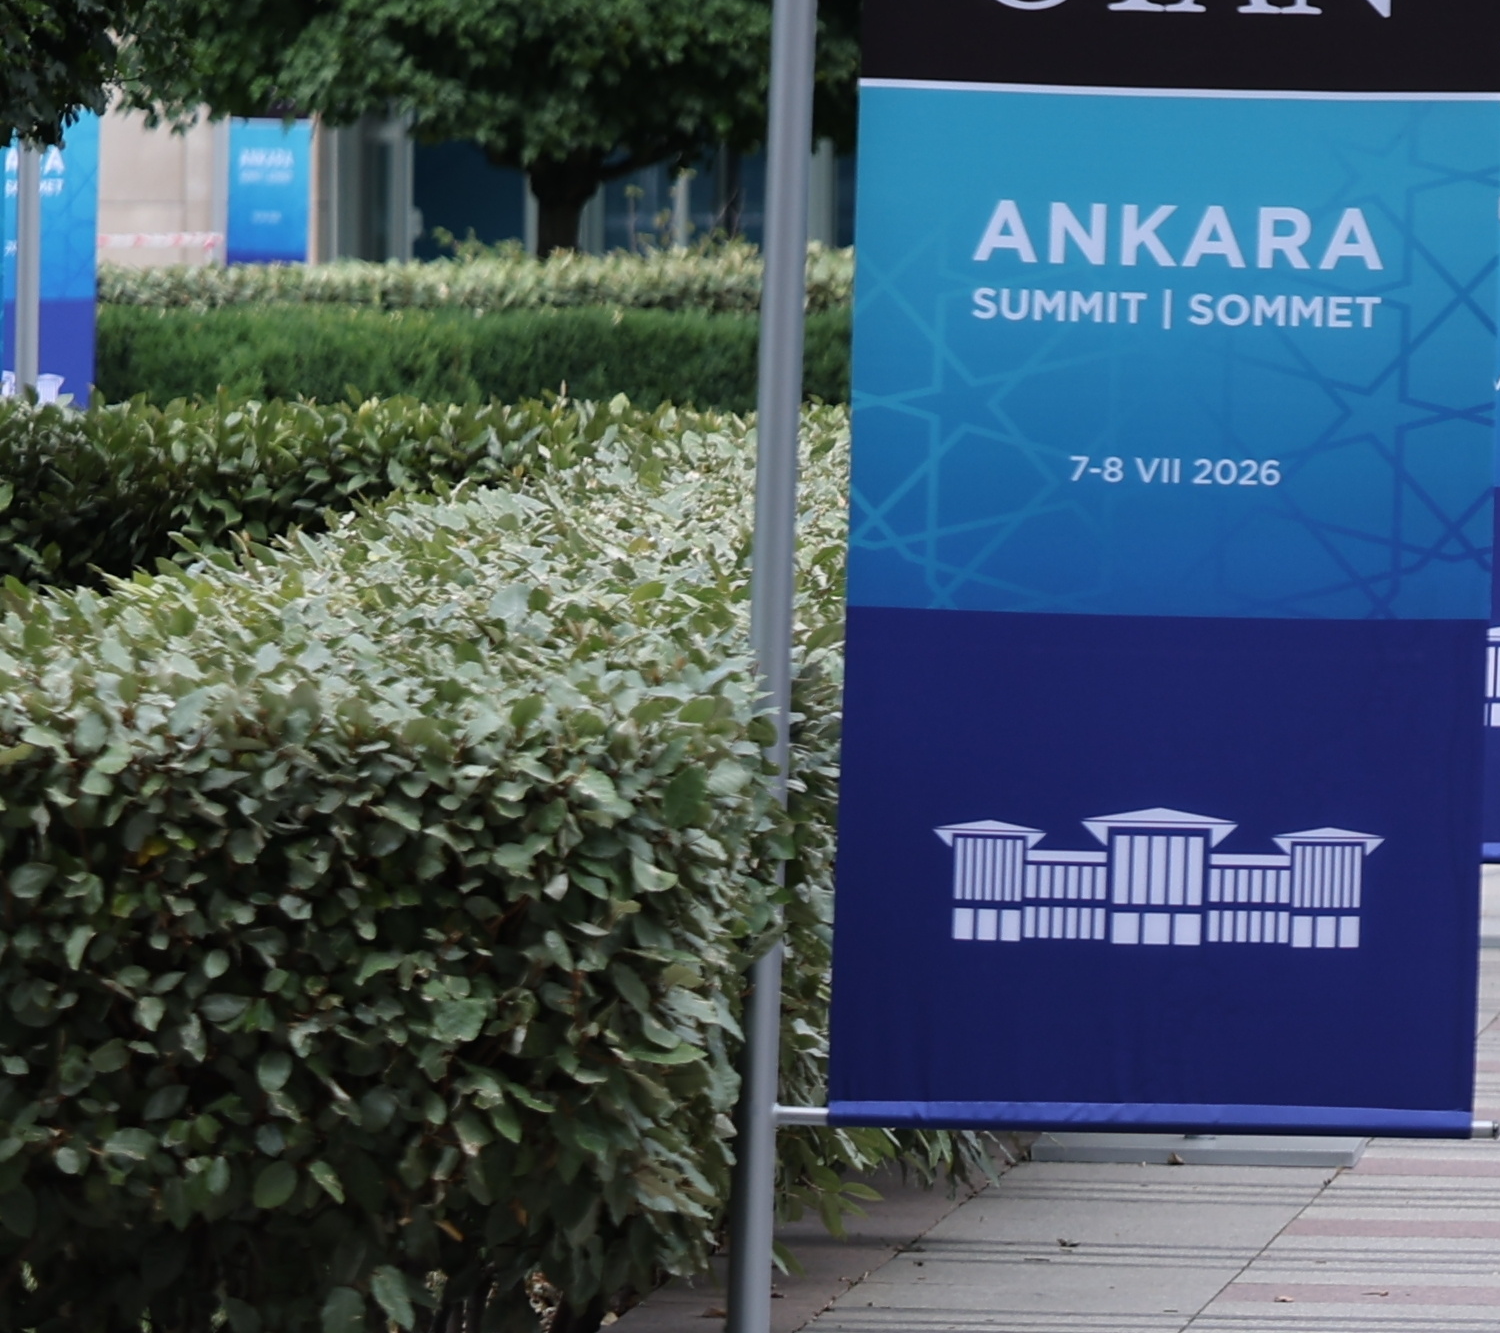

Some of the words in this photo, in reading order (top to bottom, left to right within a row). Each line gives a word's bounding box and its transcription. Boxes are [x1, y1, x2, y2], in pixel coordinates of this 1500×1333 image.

[973, 200, 1383, 270] ANKARA
[973, 288, 1147, 323] SUMMIT
[1189, 294, 1381, 327] SOMMET
[1070, 456, 1123, 482] 7-8
[1137, 458, 1180, 483] VII
[1193, 459, 1280, 486] 2026
